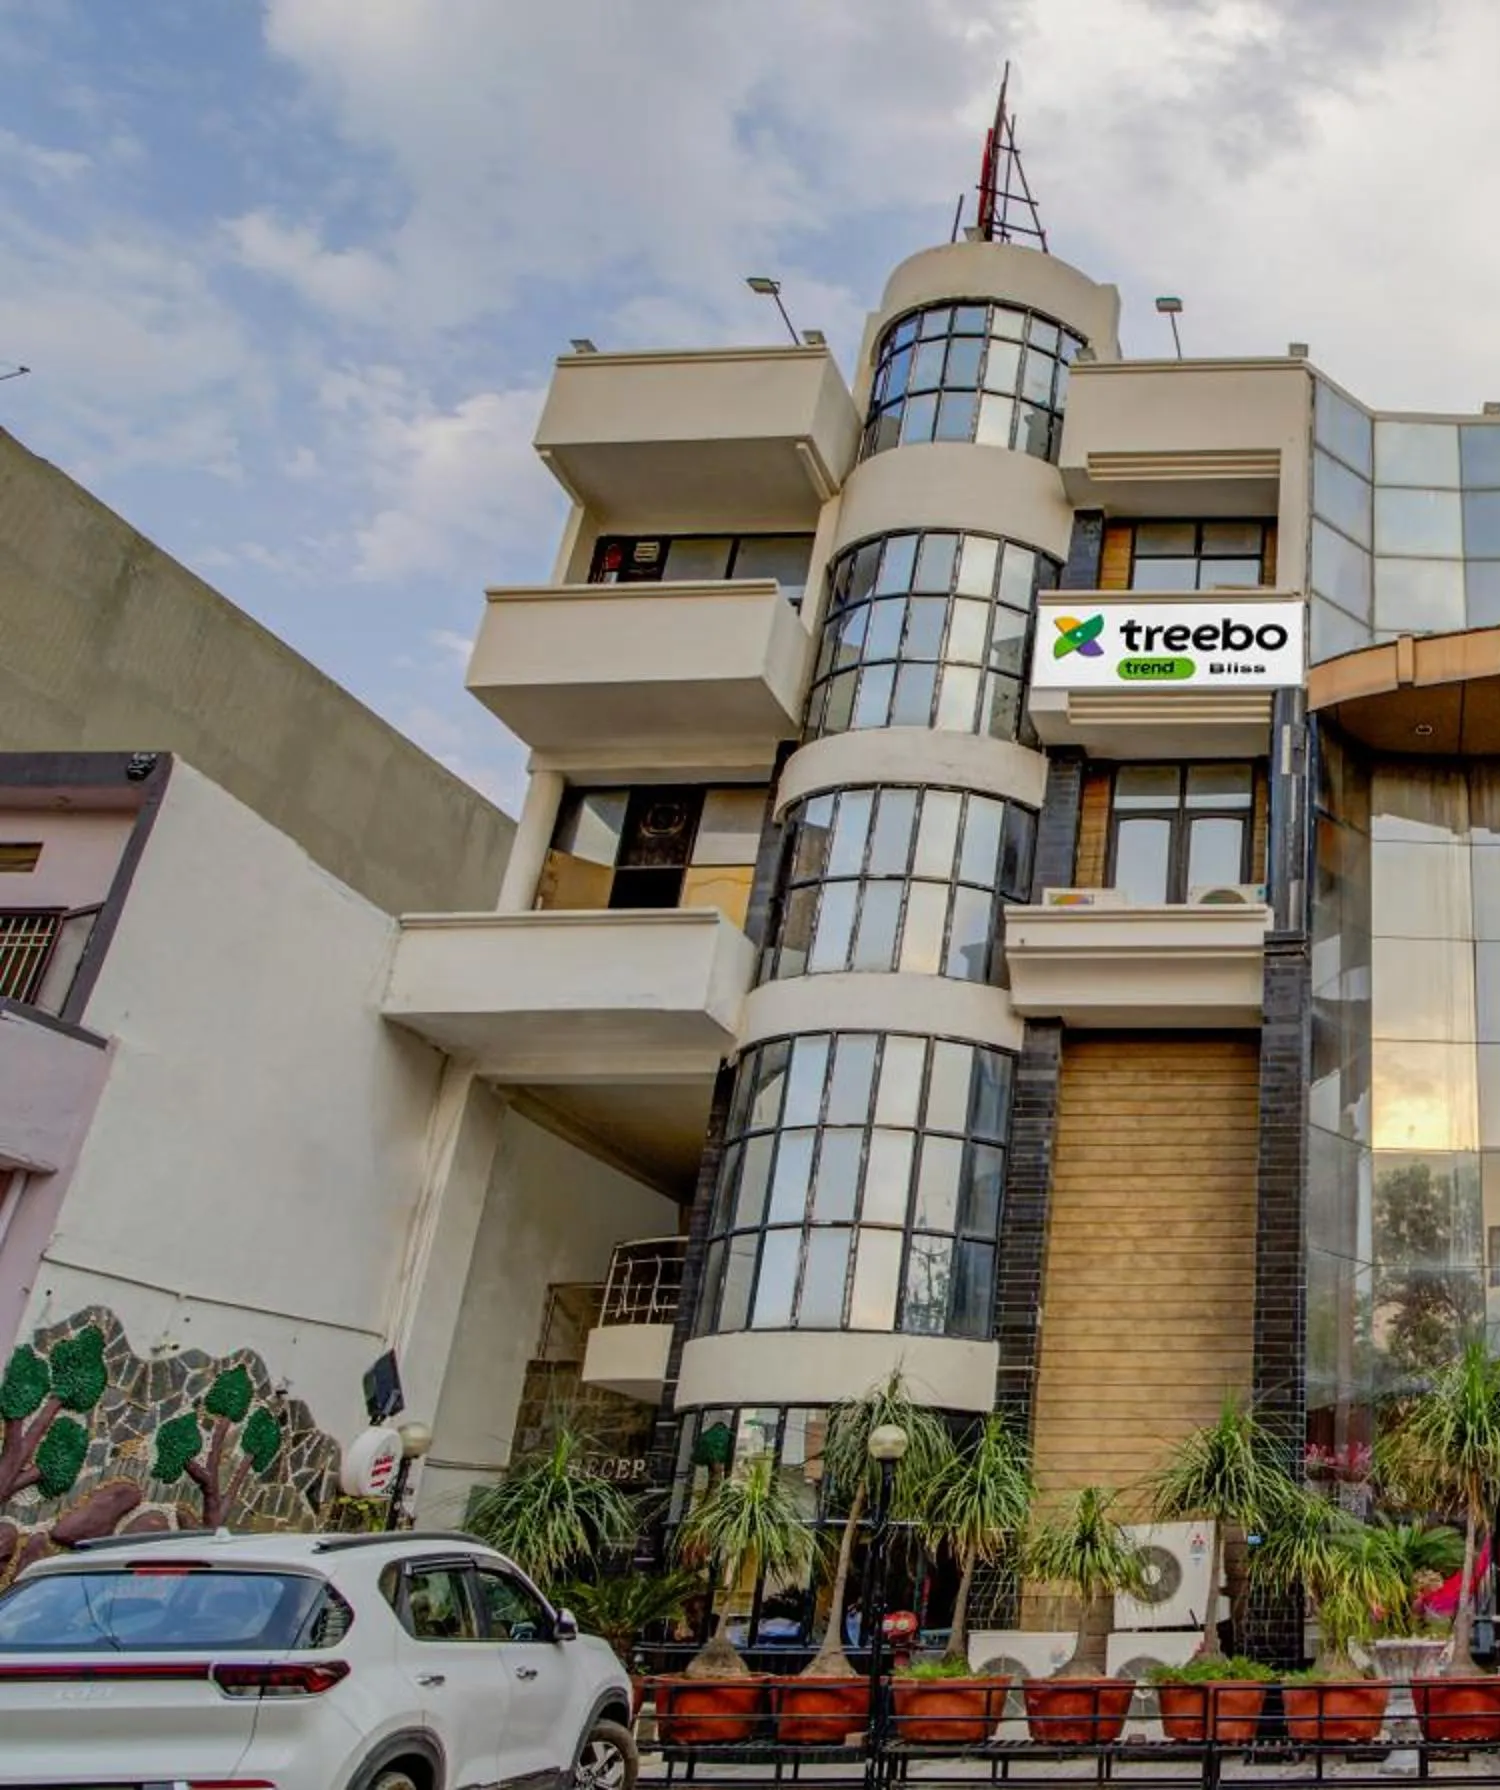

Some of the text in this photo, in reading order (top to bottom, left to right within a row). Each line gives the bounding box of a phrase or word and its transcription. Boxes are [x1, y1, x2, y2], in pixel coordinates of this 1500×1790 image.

[1119, 618, 1288, 652] treebo
[1125, 660, 1266, 675] trend Bliss
